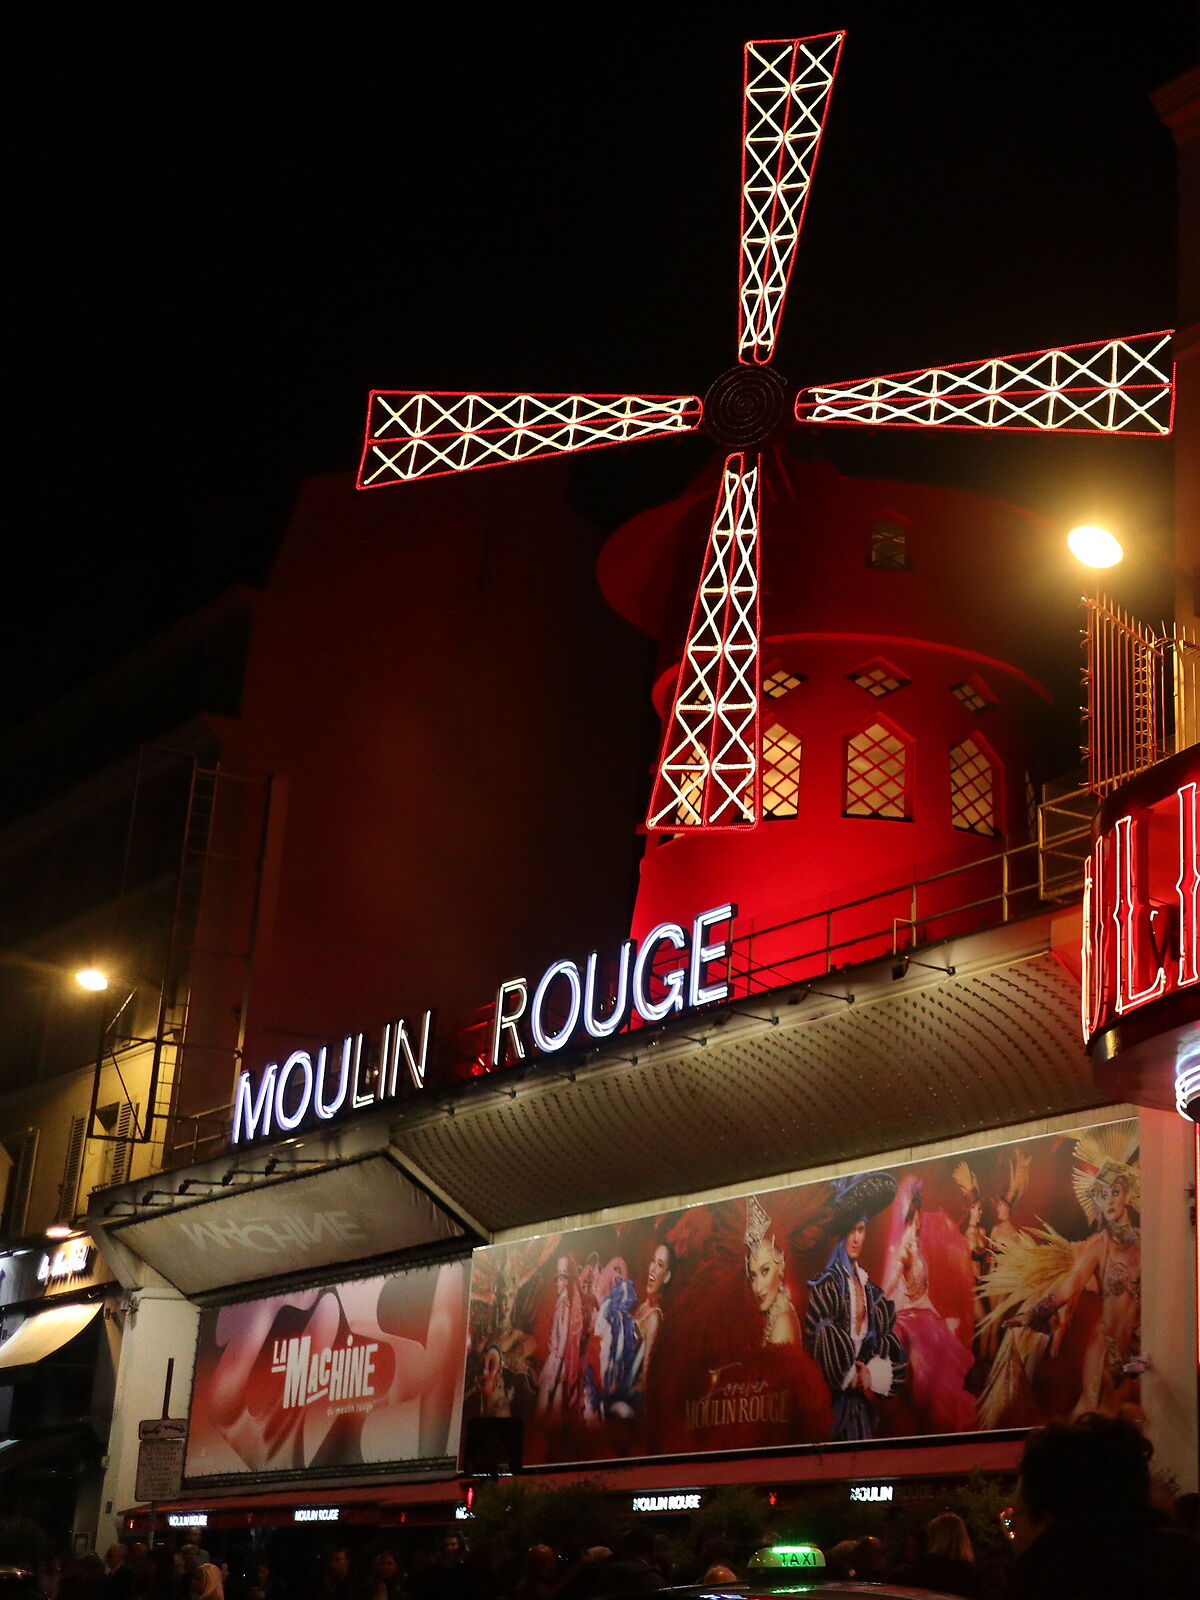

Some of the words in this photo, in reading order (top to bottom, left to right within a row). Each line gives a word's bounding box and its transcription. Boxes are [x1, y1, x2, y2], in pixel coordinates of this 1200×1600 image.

[231, 1009, 432, 1145] MOULIN
[491, 902, 738, 1067] ROUGE
[272, 1339, 288, 1367] LA
[685, 1397, 737, 1430] MOULIN
[739, 1391, 790, 1423] ROUGE
[780, 1552, 817, 1566] TAXI
